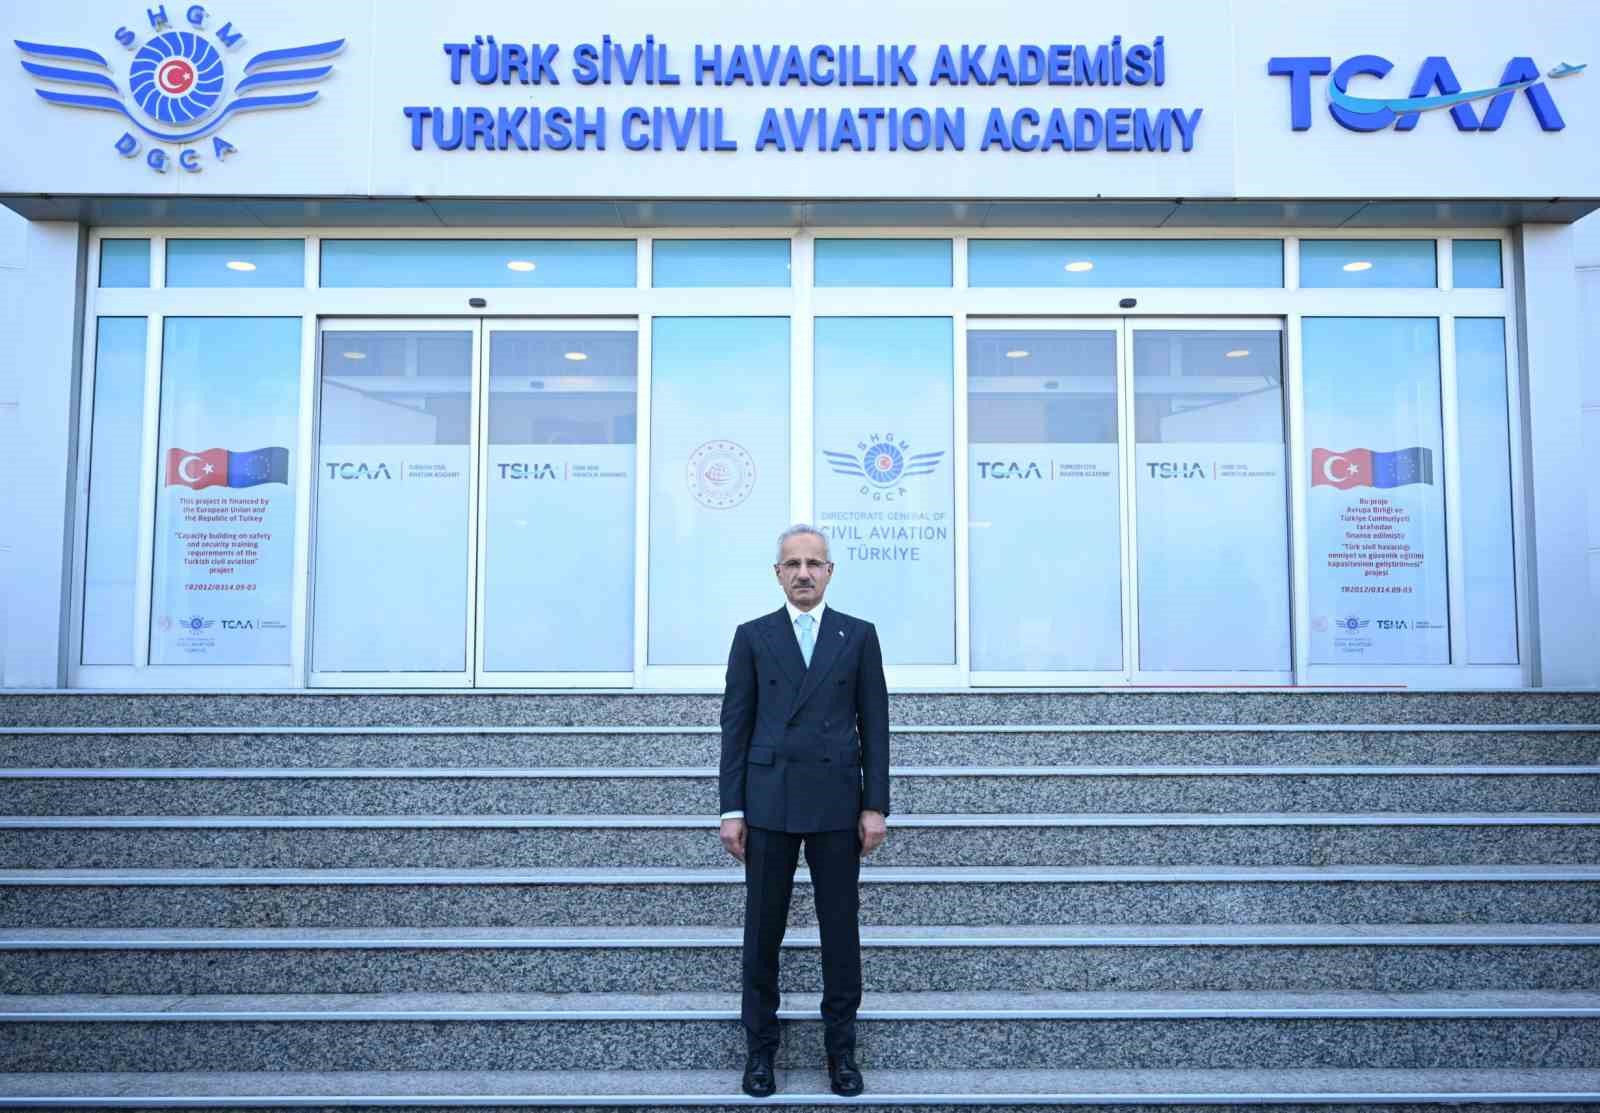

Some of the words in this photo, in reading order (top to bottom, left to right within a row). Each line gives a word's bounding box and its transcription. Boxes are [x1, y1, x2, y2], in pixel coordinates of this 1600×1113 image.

[115, 5, 244, 47] SHGM
[444, 34, 560, 86] TÜRK
[572, 33, 680, 86] SİVİL
[695, 44, 918, 87] HAVACILIK
[929, 34, 1165, 87] AKADEMİSİ
[1268, 54, 1566, 132] TCAA
[403, 106, 606, 152] TURKISH
[622, 107, 737, 152] CIVIL
[755, 107, 965, 152] AVIATION
[980, 107, 1203, 152] ACADEMY
[115, 132, 237, 172] DGCA
[326, 462, 391, 479] TCAA
[977, 462, 1042, 479] TCAA
[848, 544, 920, 561] TÜRKİYE
[869, 526, 947, 540] AVIATION
